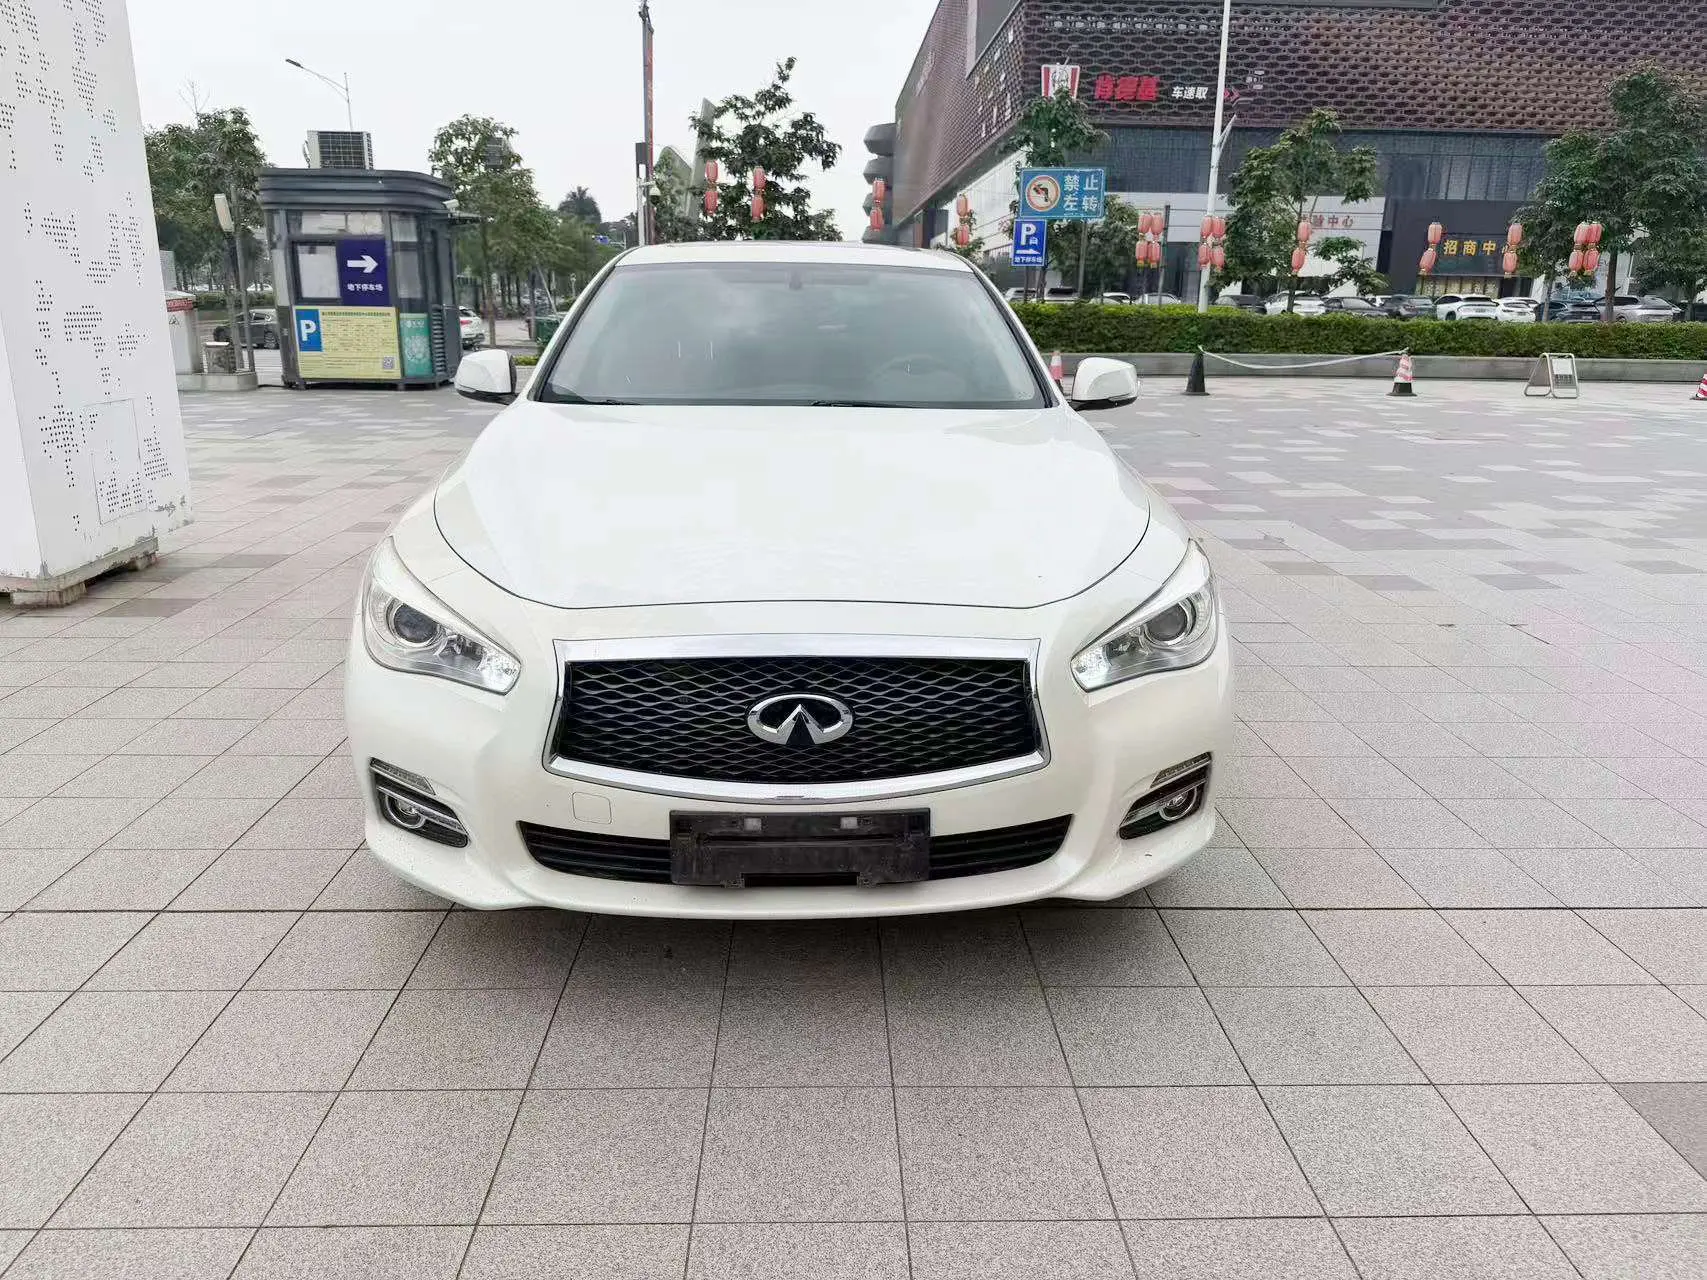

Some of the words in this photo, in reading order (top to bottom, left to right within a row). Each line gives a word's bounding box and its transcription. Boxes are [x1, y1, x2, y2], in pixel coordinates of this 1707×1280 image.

[1171, 86, 1209, 99] 车速取
[1063, 174, 1099, 192] 禁止
[1063, 194, 1098, 212] 左转
[1020, 223, 1037, 246] P
[347, 283, 384, 292] 地下停车场
[300, 319, 317, 342] P
